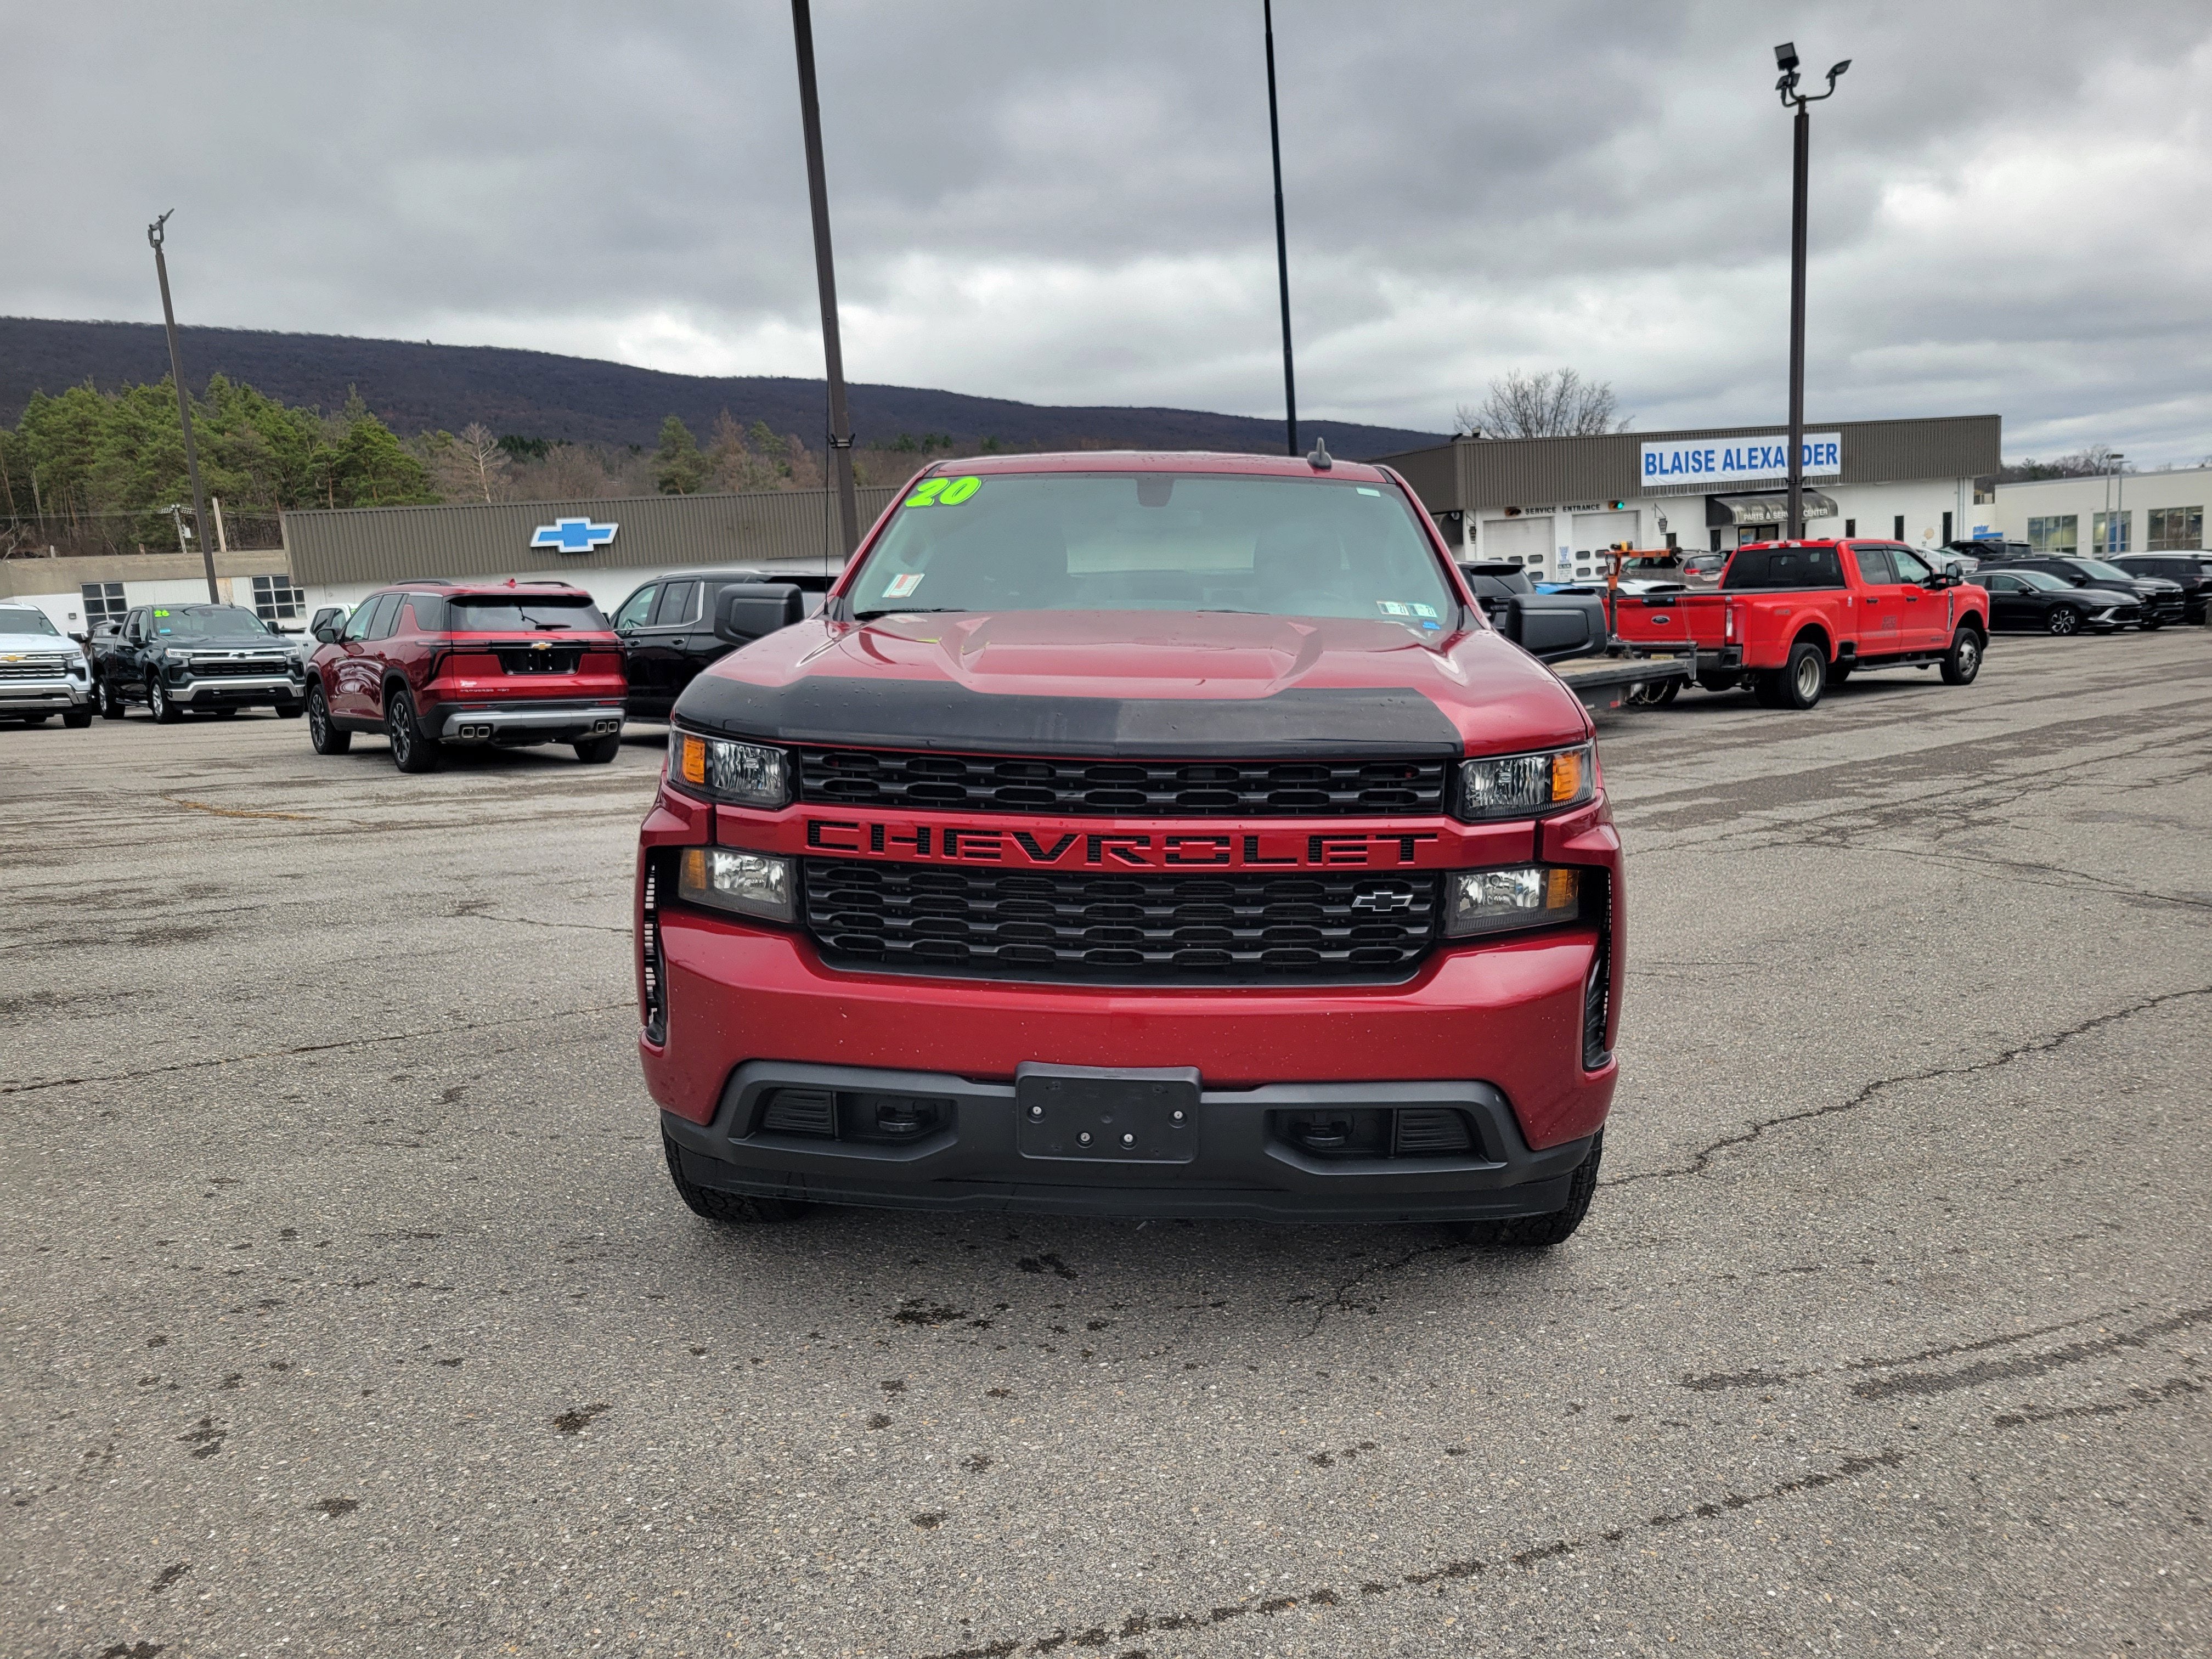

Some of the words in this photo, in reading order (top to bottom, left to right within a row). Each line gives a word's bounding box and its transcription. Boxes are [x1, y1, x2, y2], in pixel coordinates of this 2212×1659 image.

[1645, 449, 1716, 476] BLAISE
[1722, 443, 1838, 471] ALEXADER
[905, 477, 981, 507] 20
[1525, 506, 1556, 515] SERVICE
[1562, 504, 1600, 512] ENTRANCE
[1743, 512, 1764, 521] PARTS
[1803, 507, 1828, 517] CENTER
[805, 819, 1439, 866] CHEVROLET
